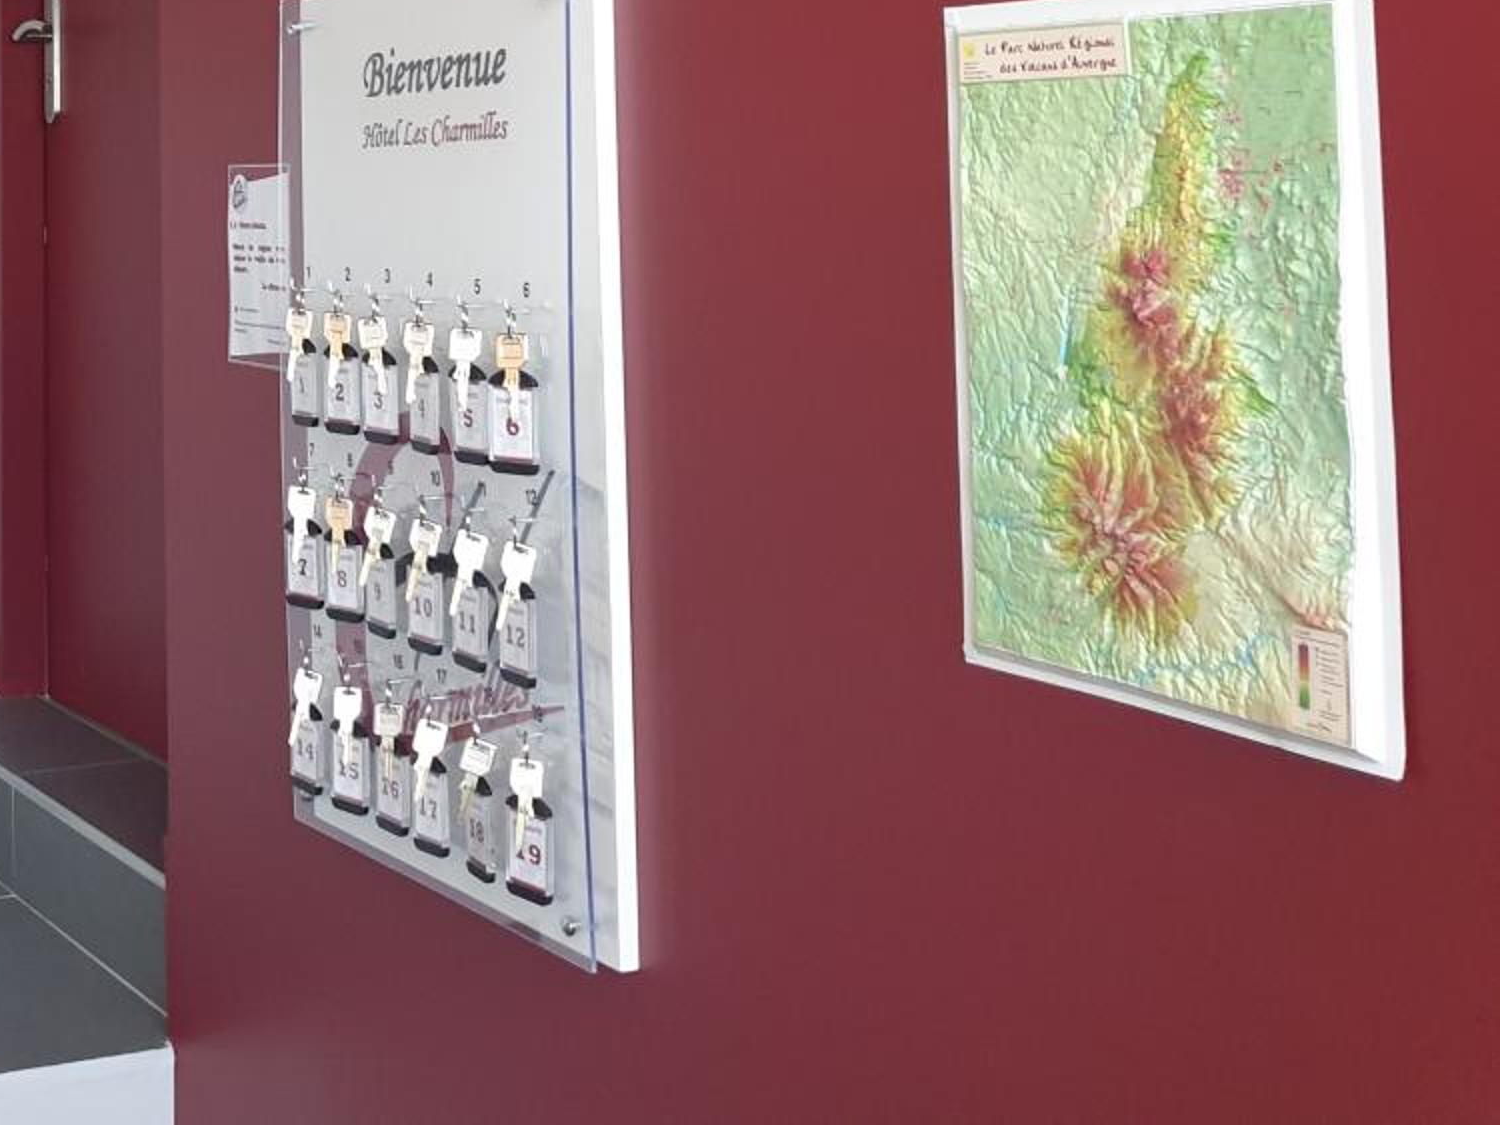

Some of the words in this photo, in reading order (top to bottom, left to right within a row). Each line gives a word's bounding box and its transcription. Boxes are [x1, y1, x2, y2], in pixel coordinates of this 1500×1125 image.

[363, 47, 507, 98] Bienvenue
[362, 118, 404, 149] Hôtel
[403, 121, 429, 147] Les
[431, 110, 509, 148] Charmilles
[383, 267, 393, 284] 3
[425, 270, 434, 288] 4
[473, 277, 482, 296] 5
[522, 281, 531, 299] 6
[334, 382, 346, 402] 2
[372, 390, 384, 410] 3
[462, 407, 474, 429] 5
[506, 415, 520, 437] 6
[297, 557, 309, 577] 7
[336, 569, 348, 589] 8
[414, 595, 434, 619] 10
[458, 610, 477, 636] 11
[506, 623, 526, 649] 12
[296, 737, 316, 761] 14
[338, 758, 359, 781] 15
[381, 776, 401, 800] 16
[419, 794, 438, 820] 17
[515, 843, 542, 867] 19
